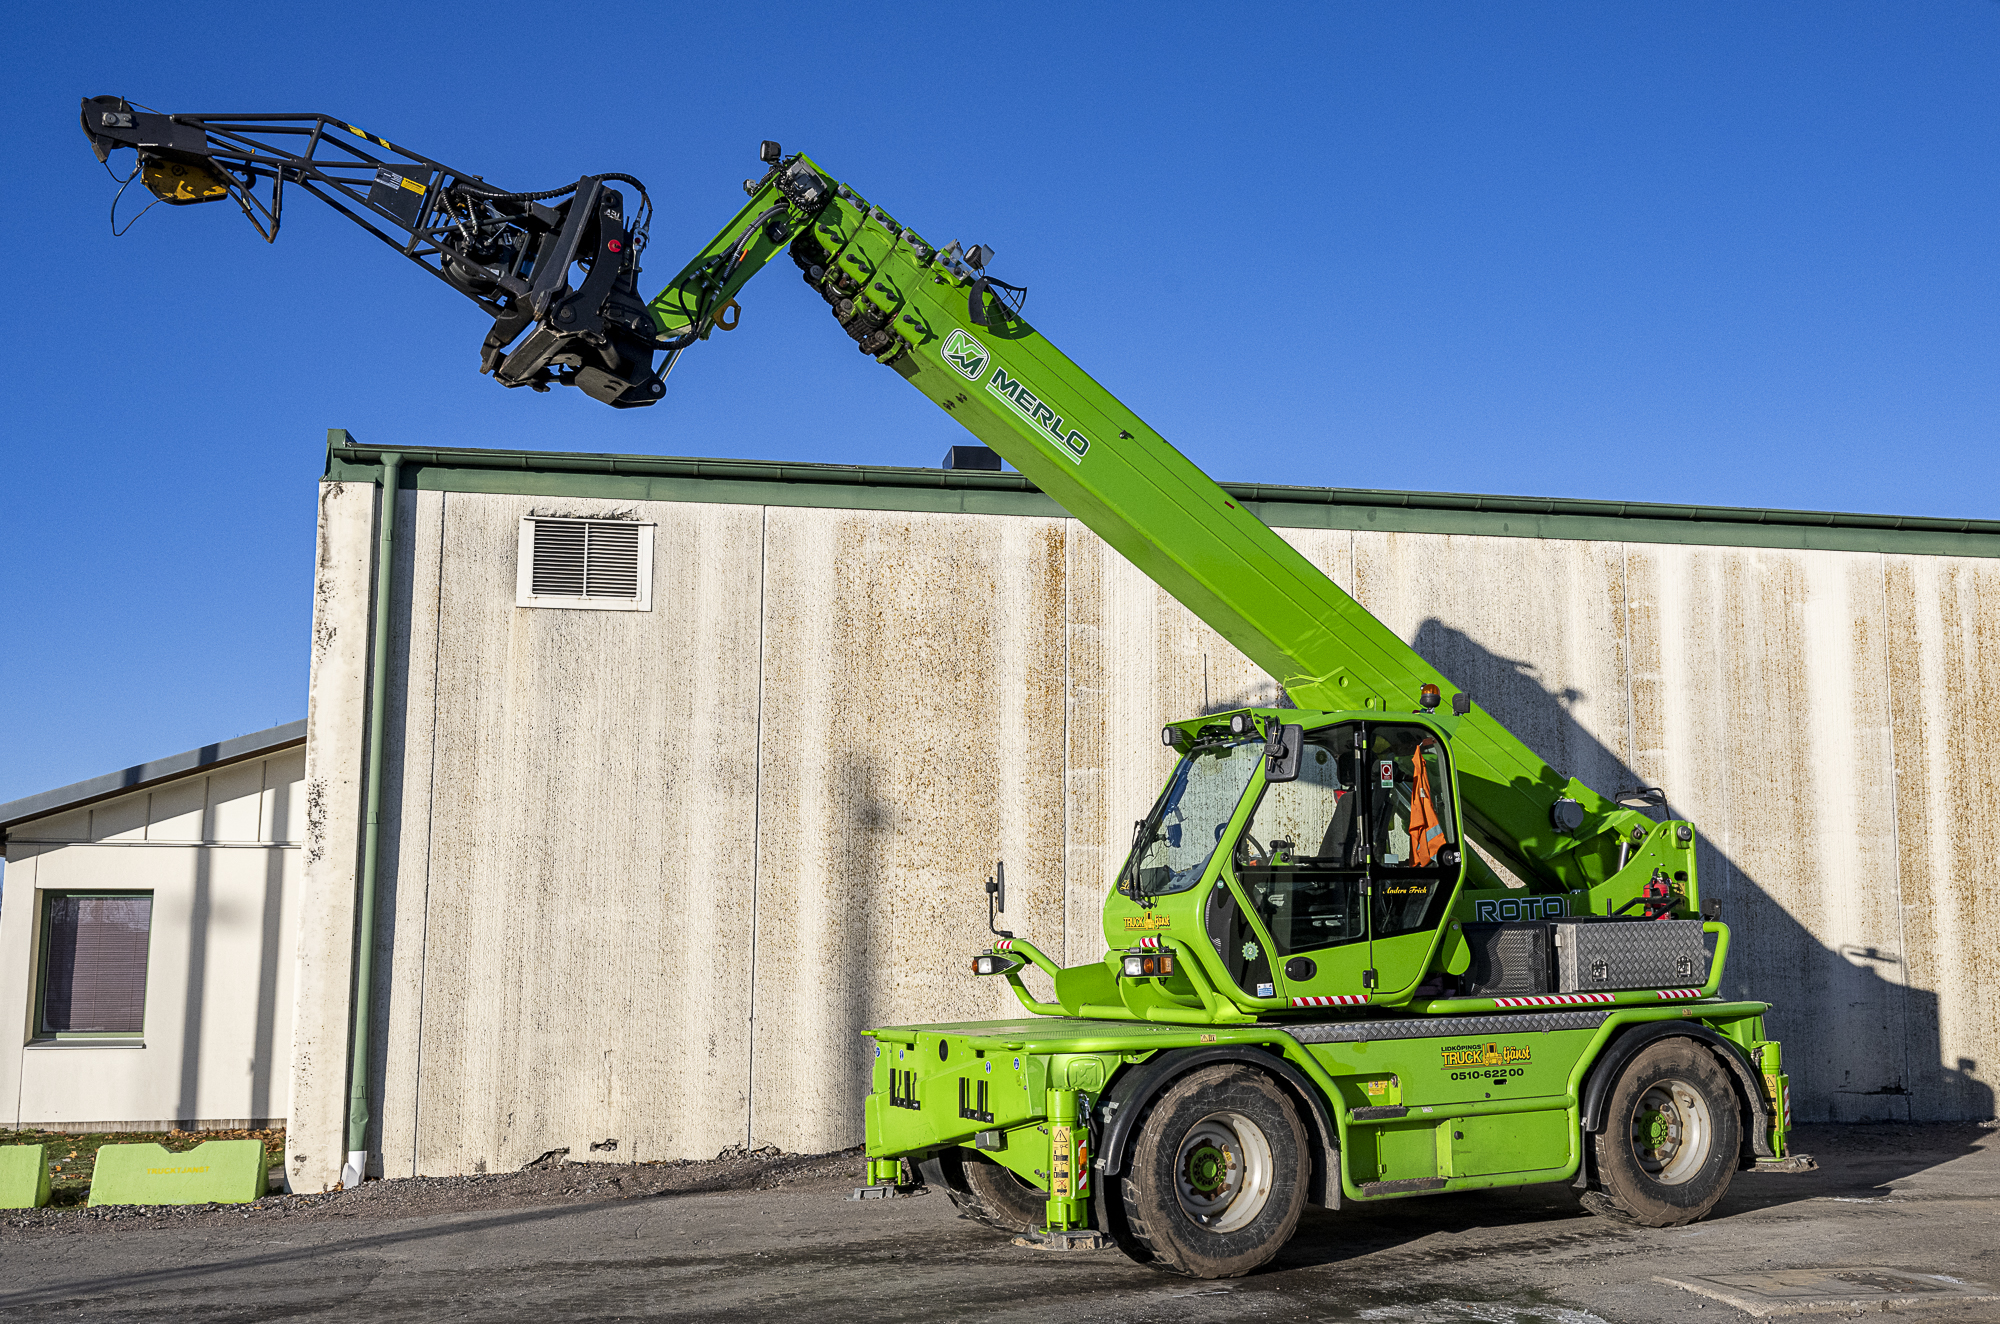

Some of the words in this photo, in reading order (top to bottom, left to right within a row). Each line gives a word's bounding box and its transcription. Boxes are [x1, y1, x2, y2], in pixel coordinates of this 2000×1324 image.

[989, 366, 1091, 457] MERLO
[1475, 896, 1565, 922] ROTO
[1123, 916, 1145, 928] TRUCK
[1441, 1044, 1482, 1052] LIDKÖPINGS
[1441, 1050, 1483, 1066] TRUCK
[1503, 1045, 1531, 1064] tjänst
